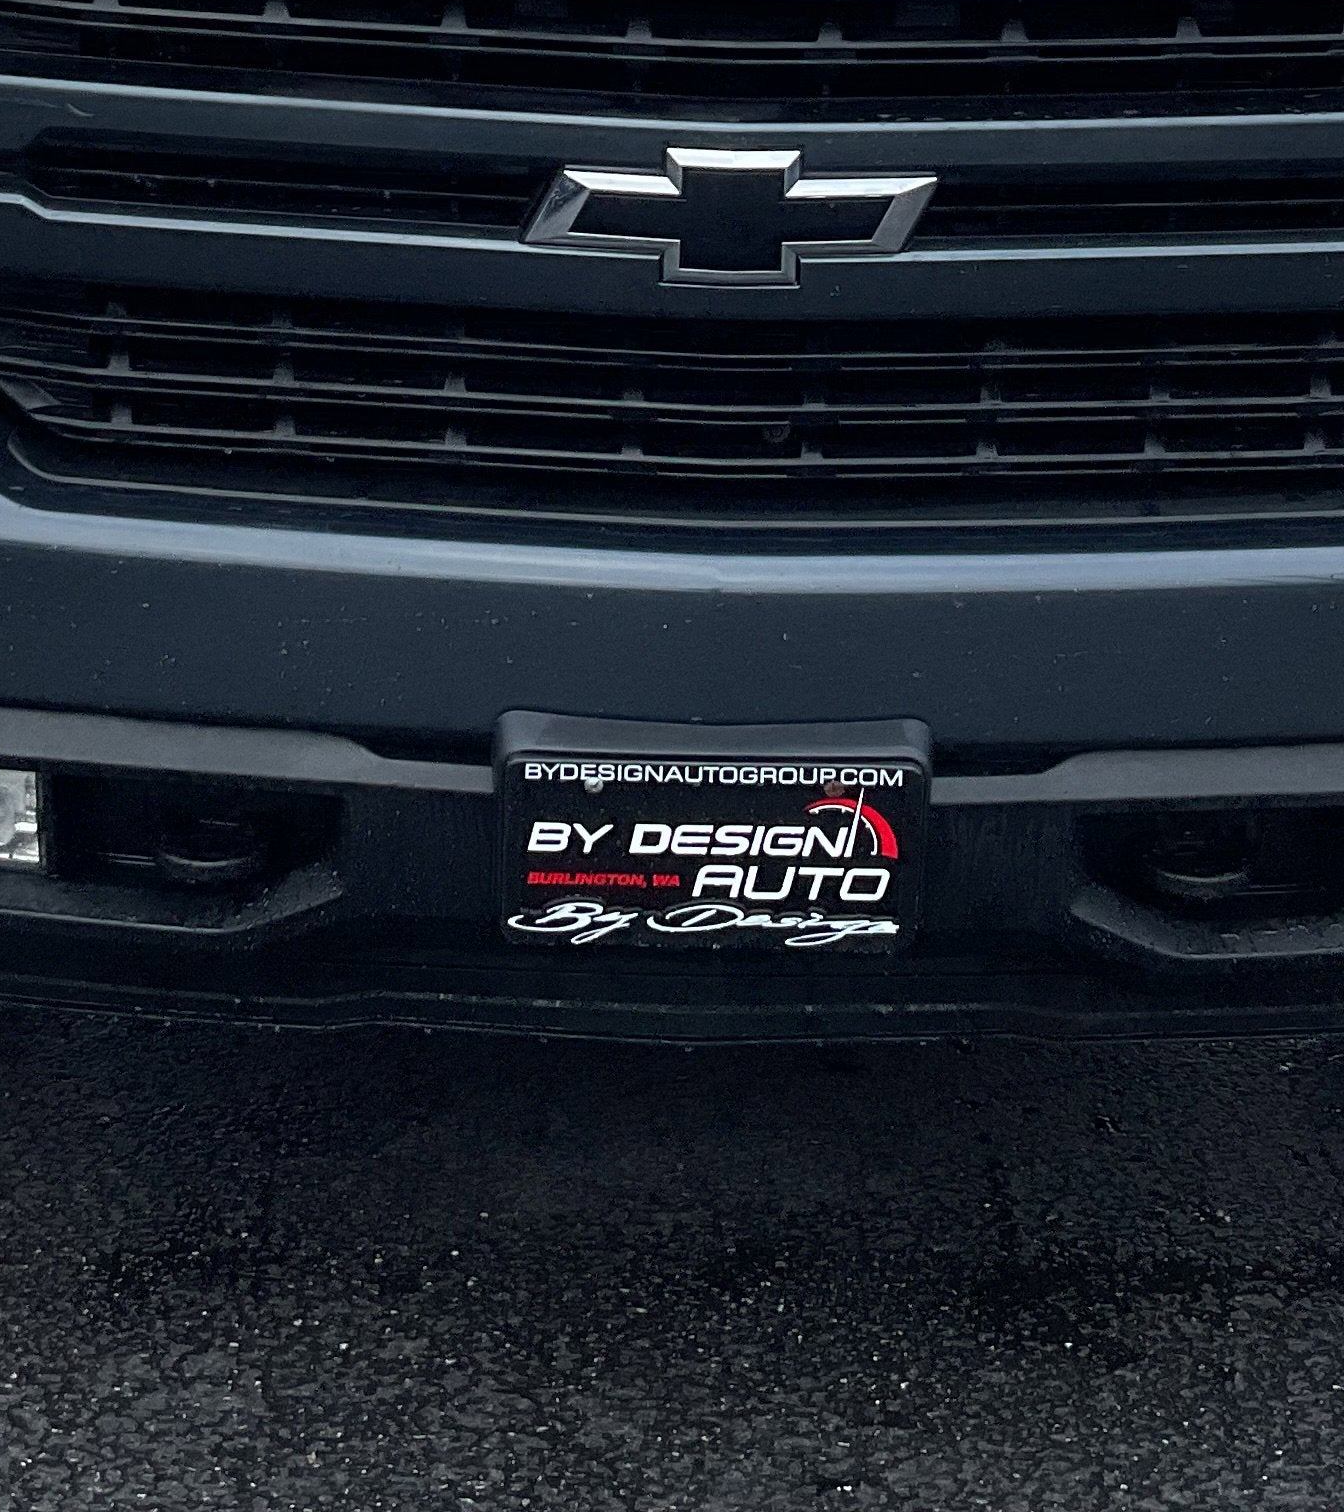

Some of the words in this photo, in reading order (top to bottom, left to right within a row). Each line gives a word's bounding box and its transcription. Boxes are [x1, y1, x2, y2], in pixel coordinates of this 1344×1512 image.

[523, 762, 904, 788] BYDESIGNAUTOGROUPCOM
[527, 822, 614, 853] BY
[629, 824, 850, 858] DESIGN
[527, 871, 647, 888] BURLINGTON,
[652, 874, 681, 887] WA
[691, 864, 891, 901] AUTO
[508, 902, 637, 945] By
